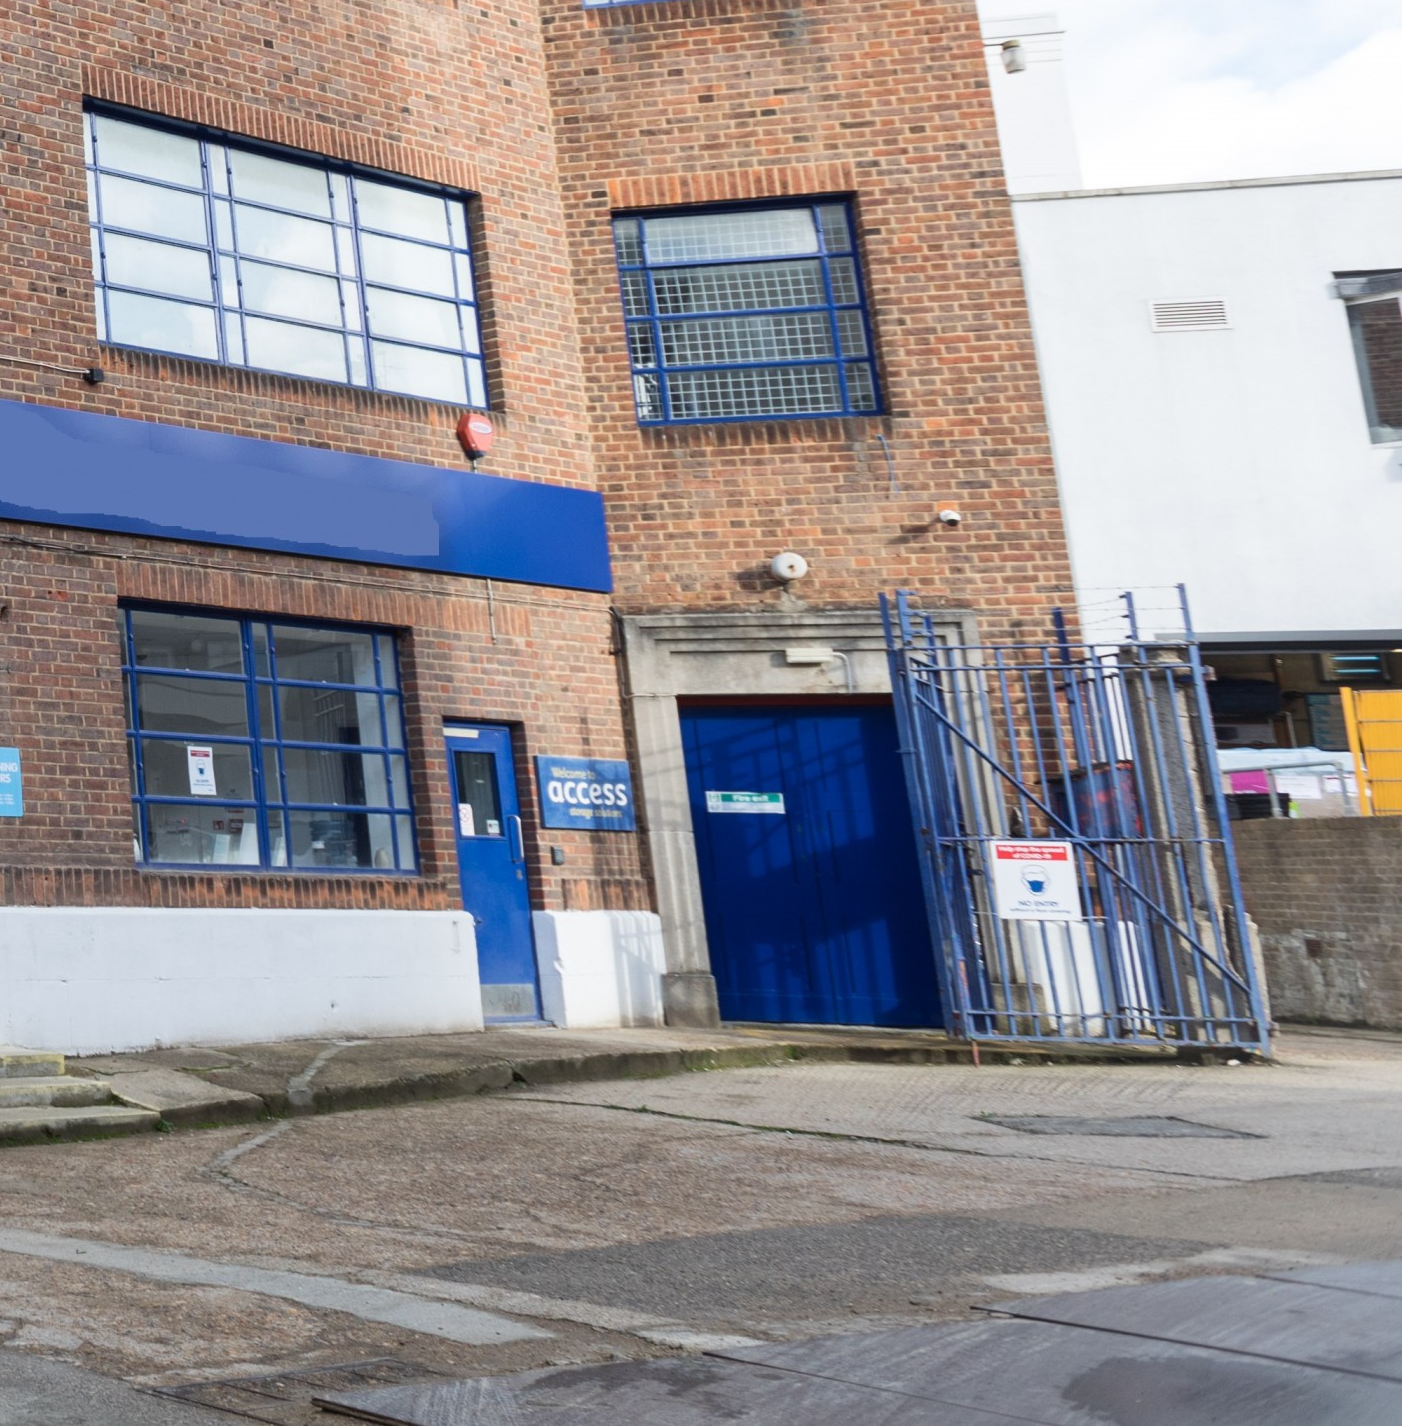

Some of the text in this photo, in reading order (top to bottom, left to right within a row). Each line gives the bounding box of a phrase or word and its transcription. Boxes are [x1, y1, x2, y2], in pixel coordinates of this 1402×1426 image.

[550, 767, 596, 780] Welcome to
[547, 780, 628, 806] access
[732, 794, 751, 802] Fire
[569, 807, 593, 820] storage
